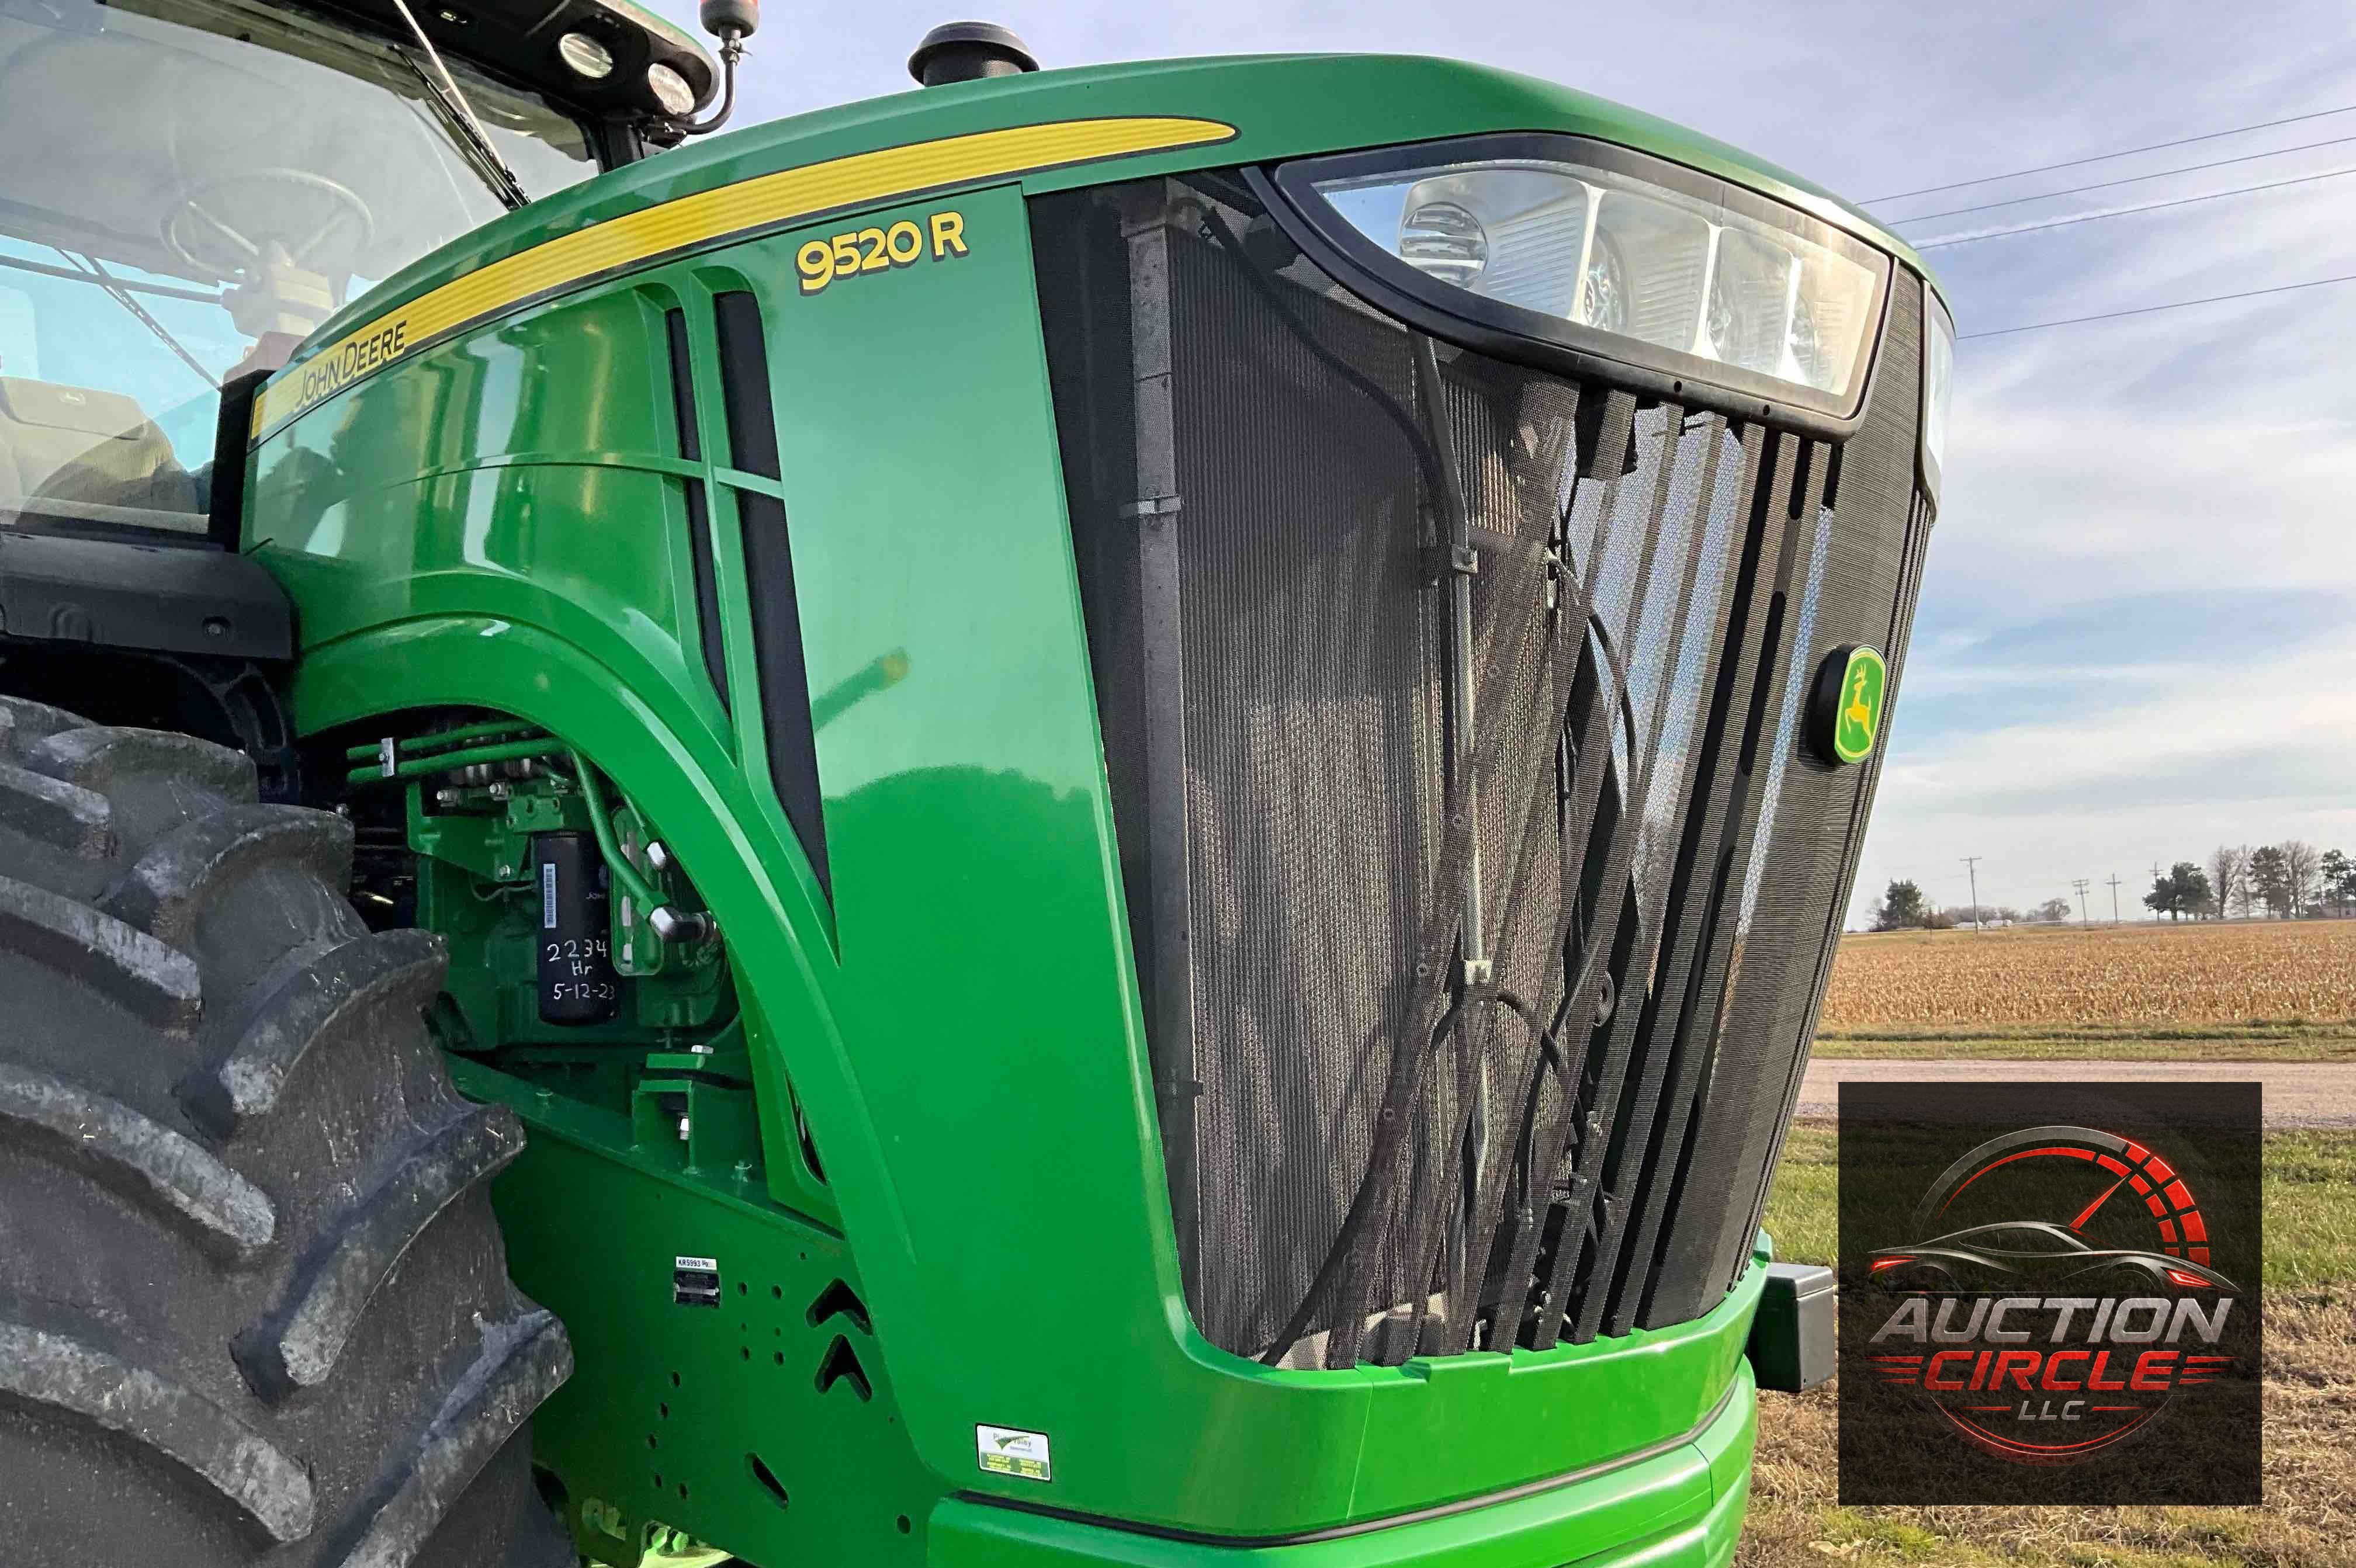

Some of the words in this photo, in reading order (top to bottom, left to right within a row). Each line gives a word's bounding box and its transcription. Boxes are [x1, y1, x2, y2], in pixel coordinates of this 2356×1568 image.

[795, 220, 922, 296] 9520
[928, 210, 970, 262] R
[294, 355, 342, 408] JOHN
[343, 320, 407, 379] DEERE
[547, 939, 607, 962] 2234
[571, 961, 593, 976] Hr
[553, 983, 615, 1000] 5-12-23
